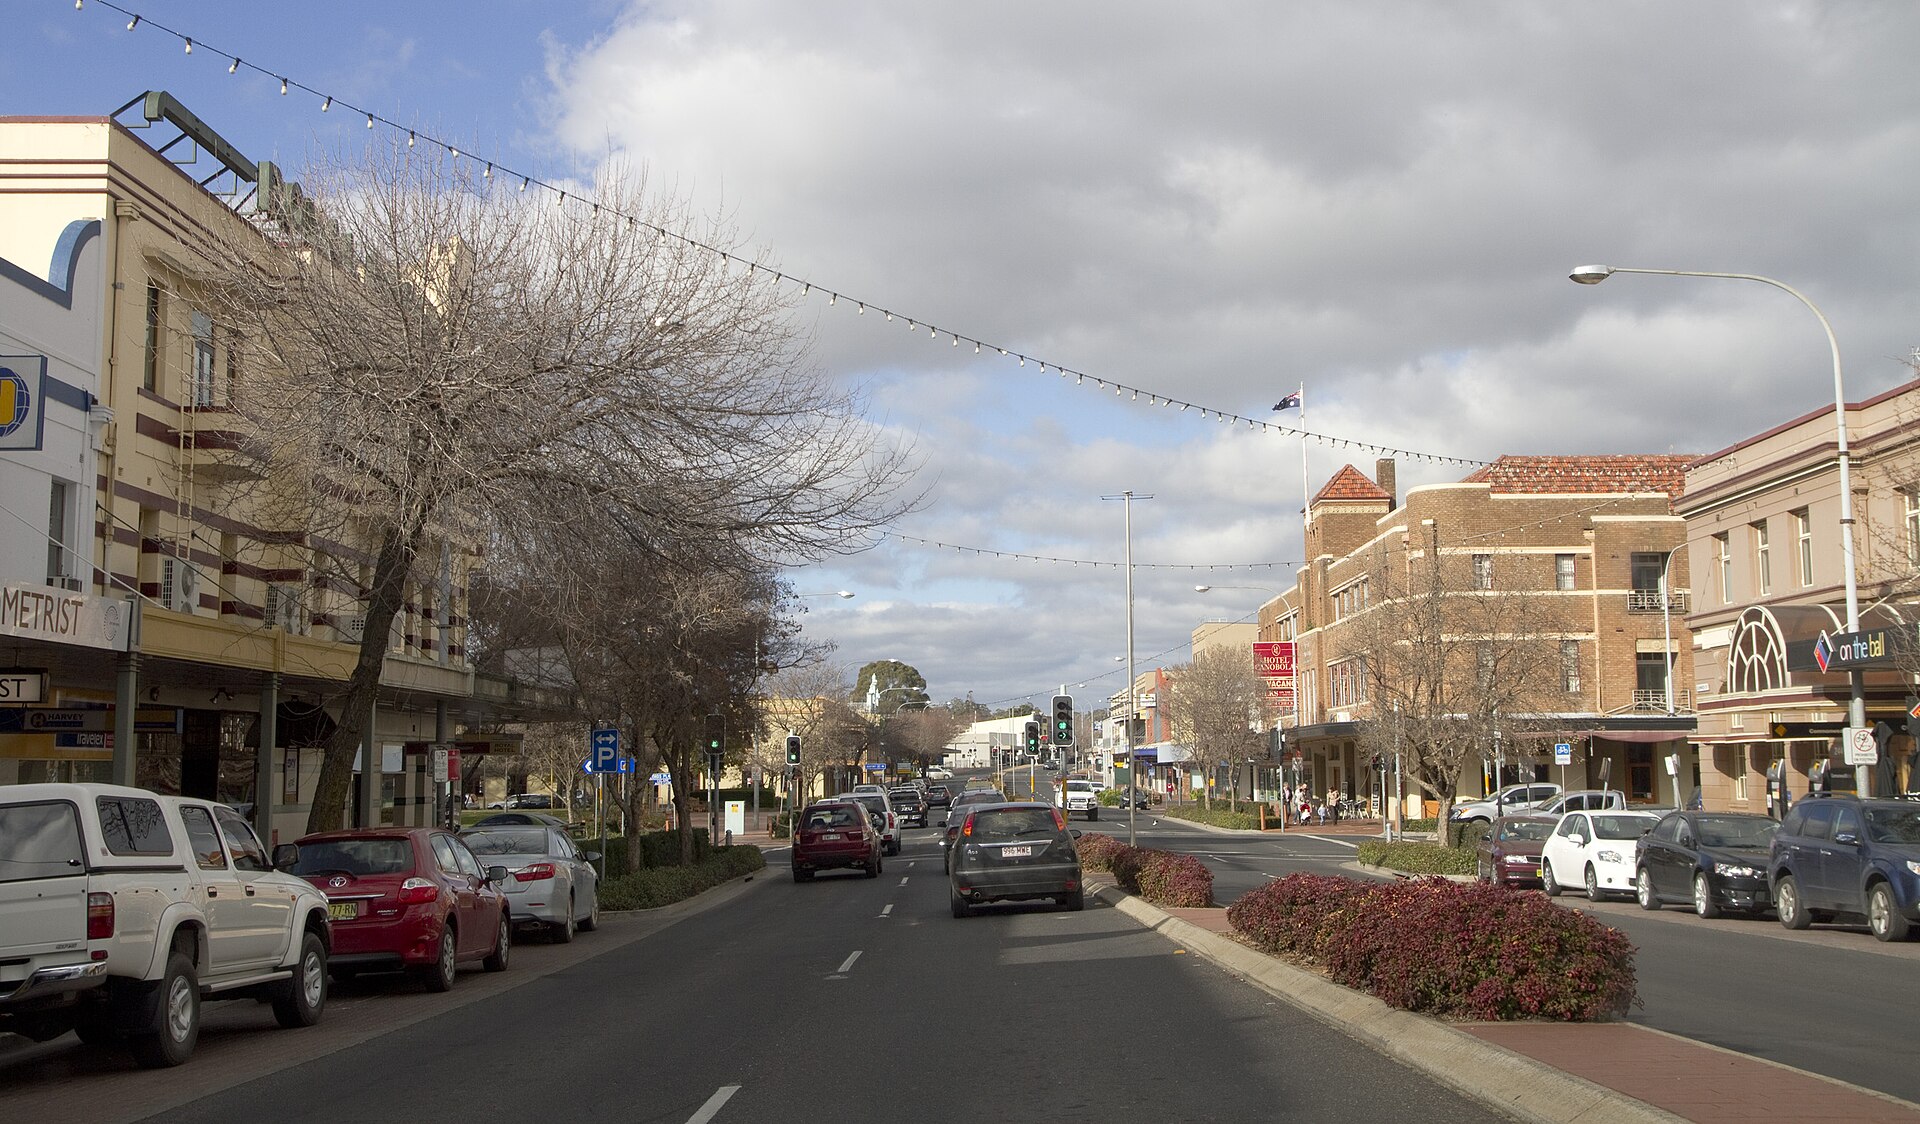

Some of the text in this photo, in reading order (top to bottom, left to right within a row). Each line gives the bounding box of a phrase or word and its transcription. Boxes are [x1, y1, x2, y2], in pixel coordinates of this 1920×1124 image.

[1840, 632, 1885, 660] on the ball
[48, 713, 84, 721] HARVEY
[597, 747, 615, 768] P
